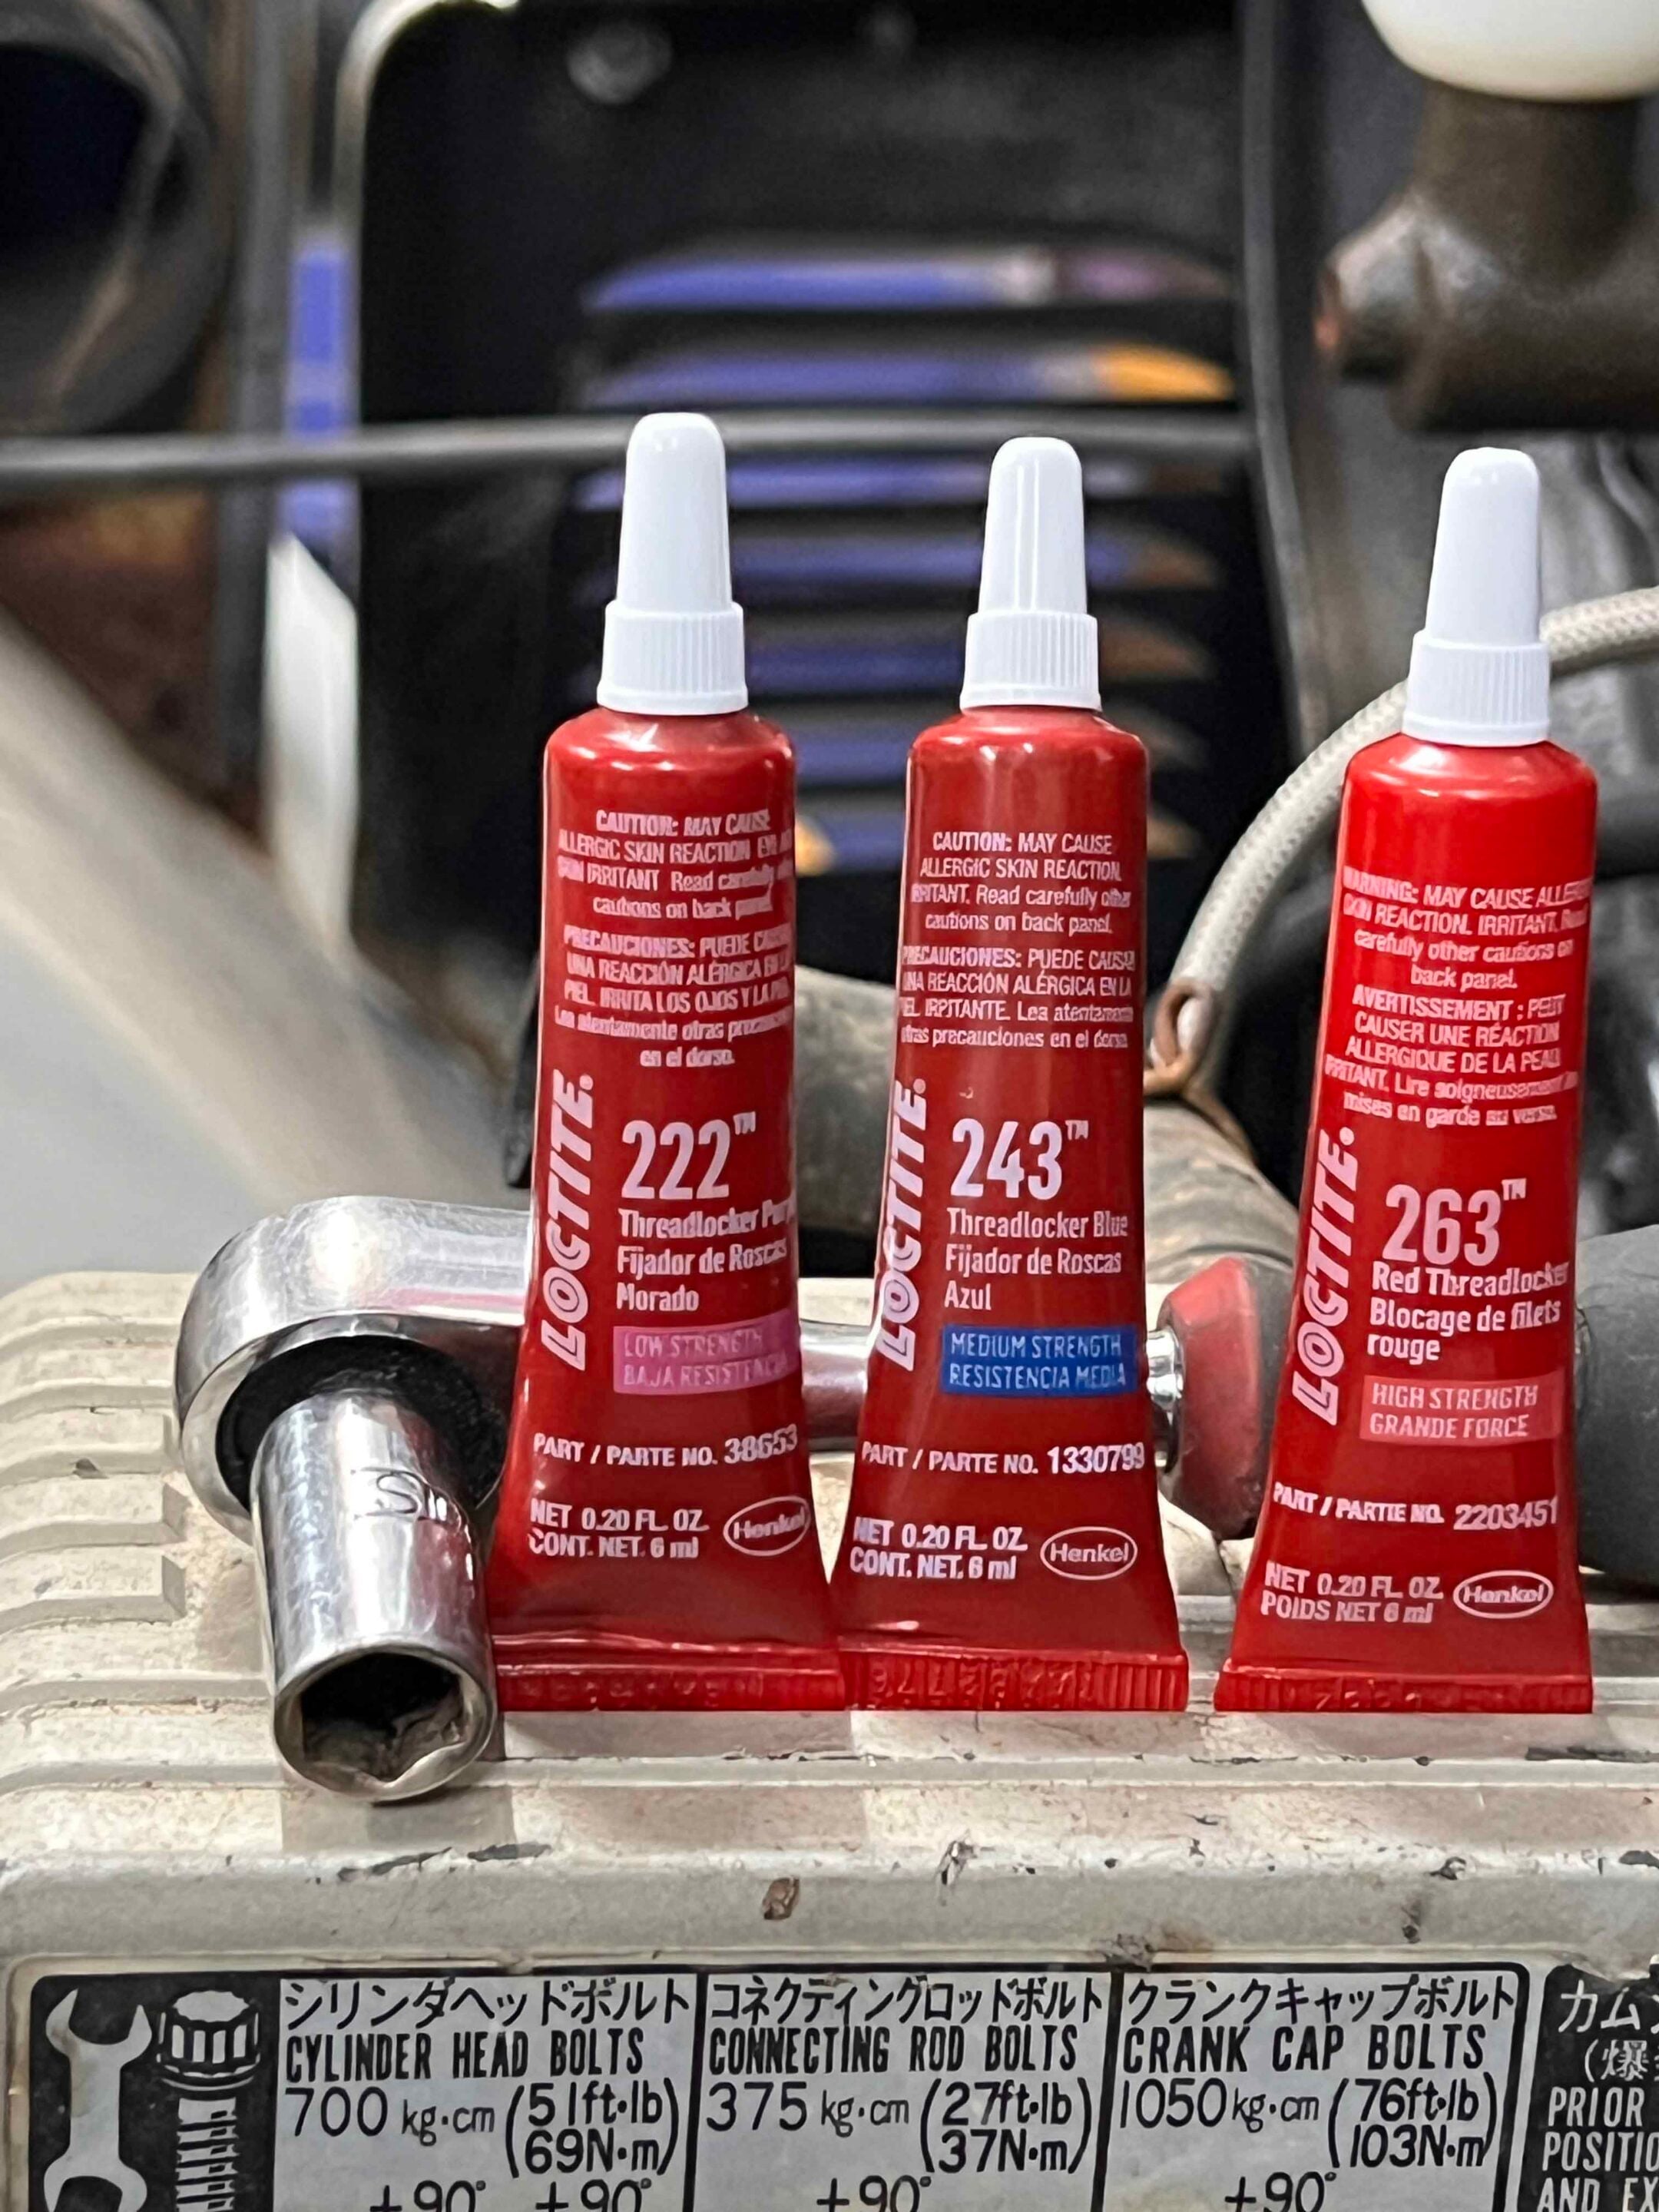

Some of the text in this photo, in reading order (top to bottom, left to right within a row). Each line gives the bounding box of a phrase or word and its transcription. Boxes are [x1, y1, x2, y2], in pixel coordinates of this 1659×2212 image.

[596, 810, 721, 836] CAUTION: MAY
[558, 830, 664, 863] ALLERGIC SKIN
[932, 832, 1112, 855] CAUTION: MAY CAUSE
[671, 870, 713, 892] Read
[920, 858, 1038, 879] ALLERGIC SKIN
[666, 902, 687, 919] on
[976, 884, 1096, 911] Read carefully
[1423, 885, 1535, 909] MAY CAUSE
[926, 912, 1064, 932] cautions on back
[1028, 949, 1084, 969] PUEDE
[1354, 929, 1423, 961] carefully
[1428, 940, 1480, 962] other
[567, 952, 594, 977] UNA
[1411, 964, 1456, 988] back
[1013, 969, 1095, 996] ALÉRGICA
[657, 988, 738, 1012] LOS OJOS
[1018, 1003, 1048, 1022] Lea
[1353, 984, 1513, 1021] AVERTISSEMENT
[932, 1028, 1089, 1048] precauciones en el
[1355, 1012, 1560, 1048] CAUSER UNE RÉACTION
[1346, 1036, 1561, 1074] ALLERGIQUE DE LA PEAU
[1395, 1072, 1429, 1097] Lire
[1344, 1091, 1480, 1128] mises en garde
[618, 1208, 760, 1238] Threadlocker
[946, 1207, 1128, 1238] Threadlocker Blue
[617, 1238, 786, 1280] Fijador de Roscas
[945, 1243, 1121, 1278] Fijador de Roscas
[945, 1280, 991, 1310] Azul
[1373, 1261, 1568, 1297] Red Threadlocker
[617, 1283, 698, 1311] Morado
[1370, 1297, 1561, 1337] Blocage de filets
[624, 1329, 763, 1358] LOW STRENGTH
[952, 1333, 1121, 1359] MEDIUM STRENGTH
[1366, 1333, 1441, 1366] rouge
[624, 1350, 787, 1387] BAJA RESISTENCIA
[950, 1363, 1126, 1389] RESISTENCIA MEDIA
[1373, 1383, 1538, 1411] HIGH STRENGTH
[1369, 1413, 1529, 1439] GRANDE FORCE
[534, 1433, 584, 1461] PART
[591, 1445, 601, 1465] /
[607, 1446, 675, 1466] PARTE
[682, 1447, 718, 1466] NO.
[862, 1442, 1144, 1475] PART / PARTE NO. 1330799
[530, 1498, 630, 1532] NET 0.20
[1273, 1482, 1558, 1531] PART NO. 2203451
[733, 1511, 805, 1540] Henkel
[853, 1517, 949, 1549] NET 0.20
[528, 1529, 698, 1558] CONT. 6 ml
[1051, 1542, 1129, 1563] Henkel
[850, 1547, 1017, 1580] CONT. NET. 6 ml
[1265, 1560, 1366, 1597] NET 0.20
[1260, 1590, 1433, 1623] POIDS NET 6 ml
[1463, 1584, 1543, 1604] Henkel
[285, 1977, 689, 2029] シリンダヘッドボルト
[1558, 1979, 1659, 2034] カム
[286, 2028, 644, 2082] CYLINDER HEAD BOLTS
[710, 2024, 1078, 2075] CONNECTING ROD BOLTS
[1124, 2023, 1486, 2073] CRANK CAP BOLTS
[1585, 2039, 1659, 2082] (爆
[285, 2086, 386, 2137] 700
[706, 2081, 806, 2131] 375
[1120, 2078, 1227, 2129] 1050
[1548, 2087, 1644, 2127] PRIOR
[1538, 2177, 1600, 2212] AND
